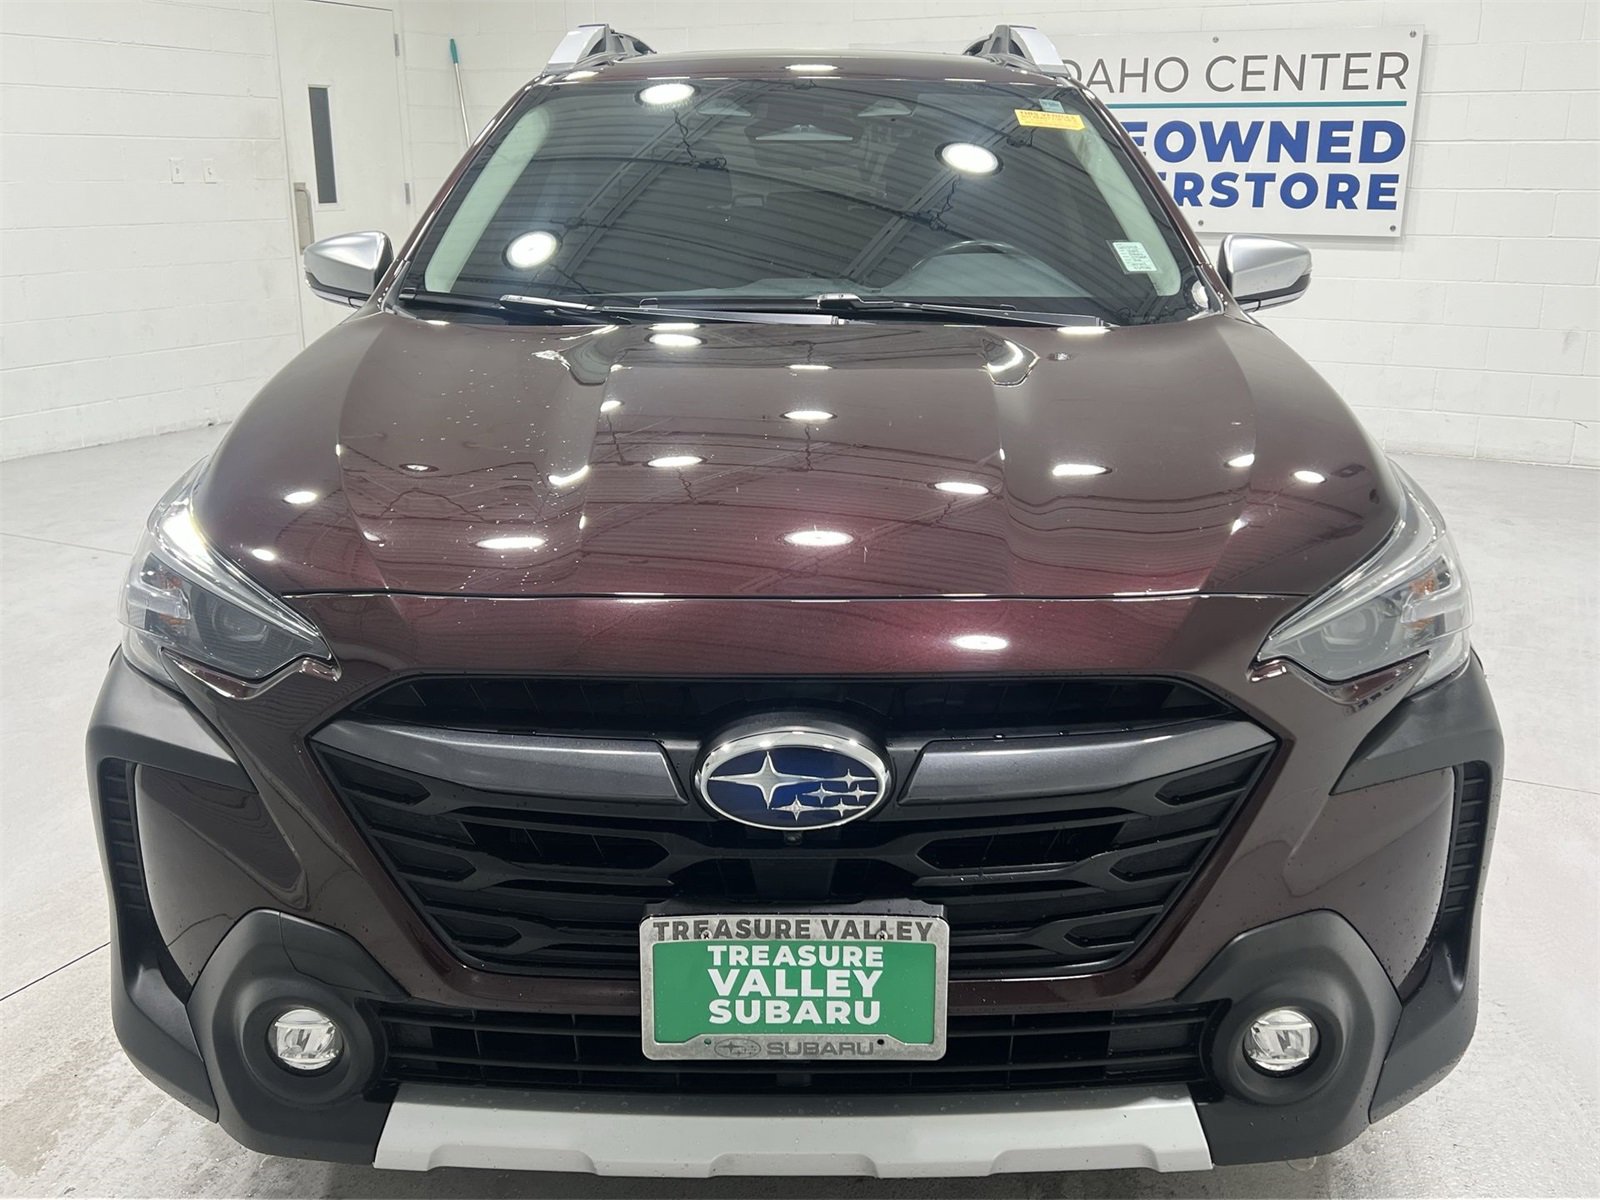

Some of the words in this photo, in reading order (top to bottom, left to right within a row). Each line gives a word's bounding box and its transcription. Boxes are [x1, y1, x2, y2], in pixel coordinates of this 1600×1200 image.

[1205, 52, 1410, 93] CENTER
[1157, 171, 1400, 210] RSTORE
[653, 919, 811, 942] TREASURE
[707, 945, 884, 967] TREASURE
[707, 969, 884, 998] VALLEY
[708, 999, 880, 1025] SUBARU
[766, 1041, 875, 1056] SUBARU
